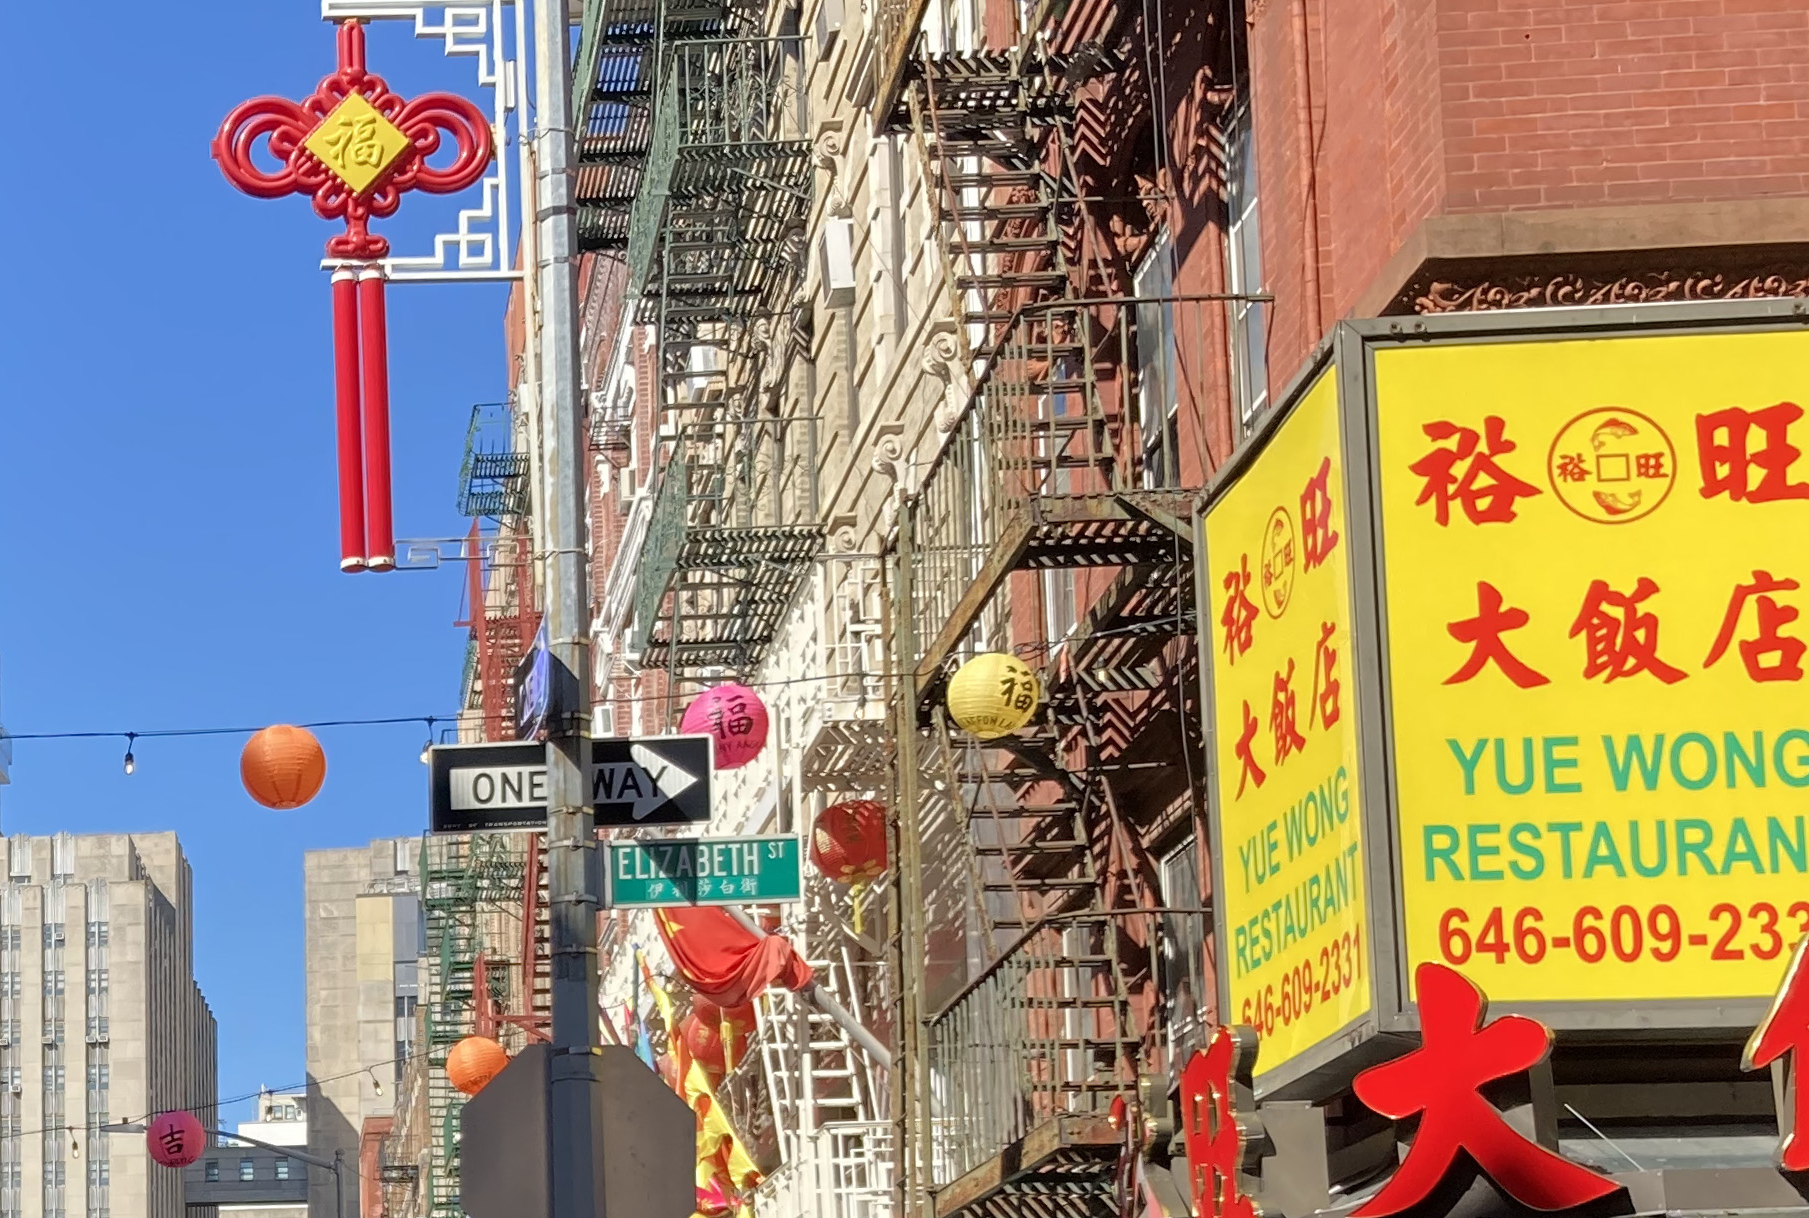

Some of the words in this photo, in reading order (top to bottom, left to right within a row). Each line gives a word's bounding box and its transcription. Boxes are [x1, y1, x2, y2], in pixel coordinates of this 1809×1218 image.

[322, 111, 385, 168] 福
[1407, 414, 1544, 528] 裕
[1694, 401, 1809, 504] 旺
[1441, 570, 1808, 690] 大飯店
[999, 665, 1034, 713] 福
[472, 770, 548, 805] ONE
[592, 765, 668, 800] WAY
[1445, 735, 1583, 796] YUE
[1601, 727, 1809, 793] WONG
[617, 842, 759, 880] ELIZABETH
[767, 841, 785, 859] ST
[1238, 818, 1280, 894] YUE
[1282, 765, 1350, 863] WONG
[1234, 840, 1358, 979] RESTAURANT
